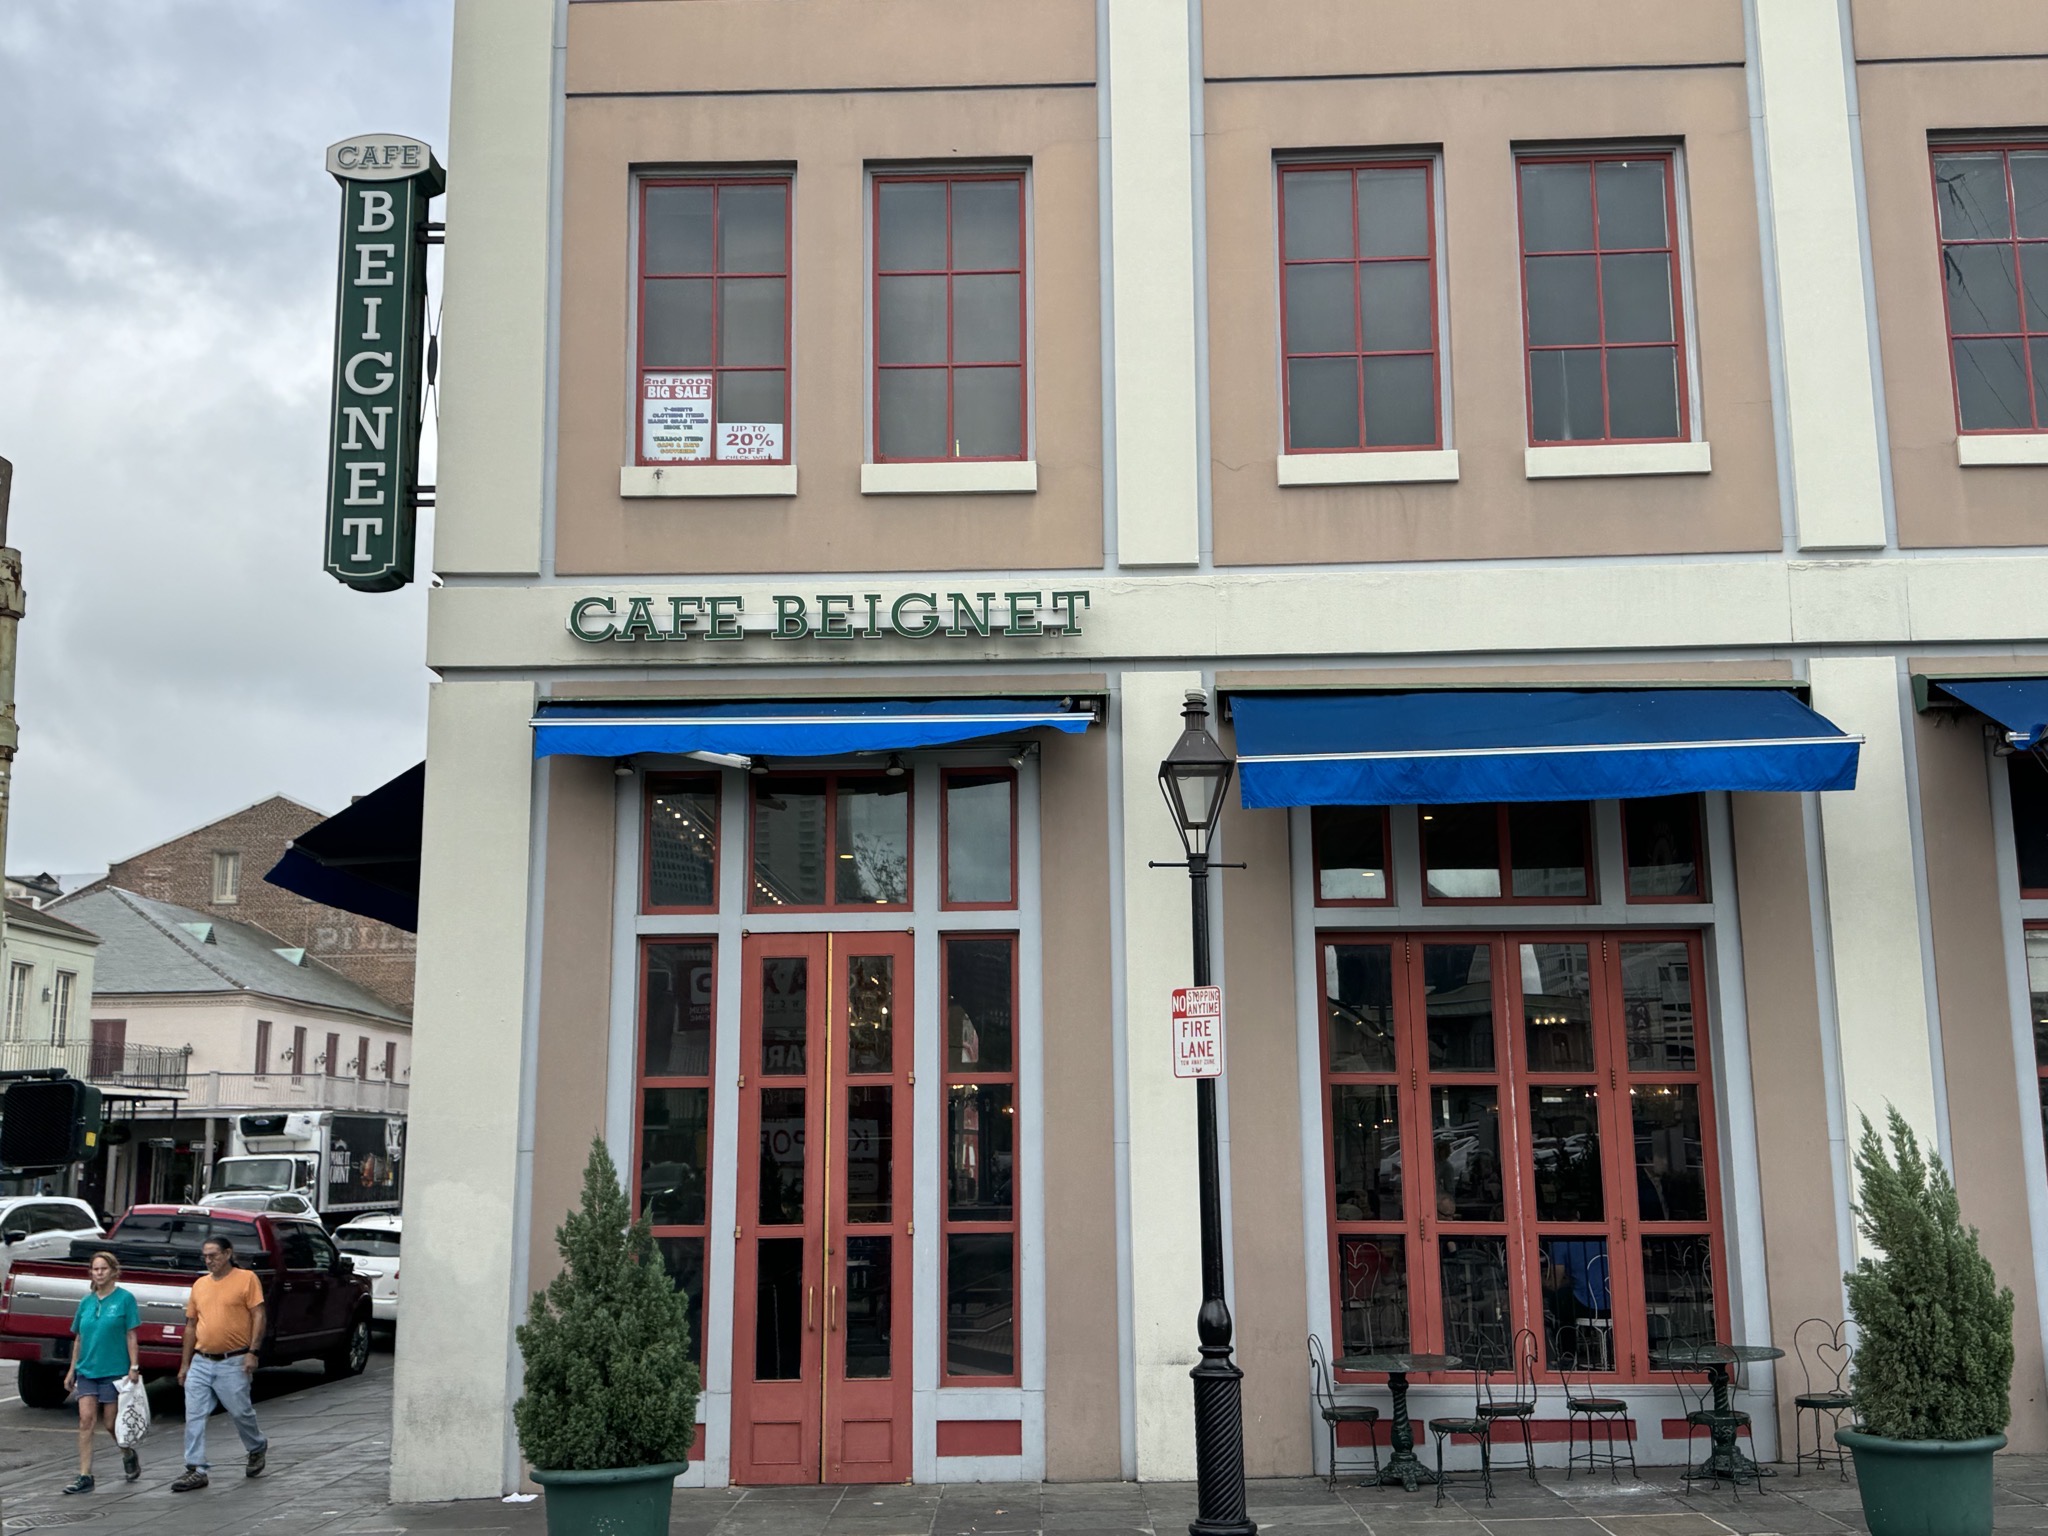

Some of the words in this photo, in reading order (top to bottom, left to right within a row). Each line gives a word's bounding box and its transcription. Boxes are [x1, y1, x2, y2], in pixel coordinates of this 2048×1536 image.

[337, 144, 420, 169] CAFE
[341, 190, 396, 561] BEIGNET
[647, 386, 670, 398] BIG
[675, 386, 708, 398] SALE
[726, 433, 775, 447] 20%
[736, 447, 765, 455] OFF
[569, 596, 745, 642] CAFE
[771, 591, 1091, 641] BEIGNET
[1172, 995, 1187, 1013] NO
[1188, 990, 1219, 1002] STOPPING
[1187, 1002, 1219, 1015] ANYTIME
[1182, 1020, 1212, 1038] FIRE
[1181, 1040, 1214, 1058] LANE
